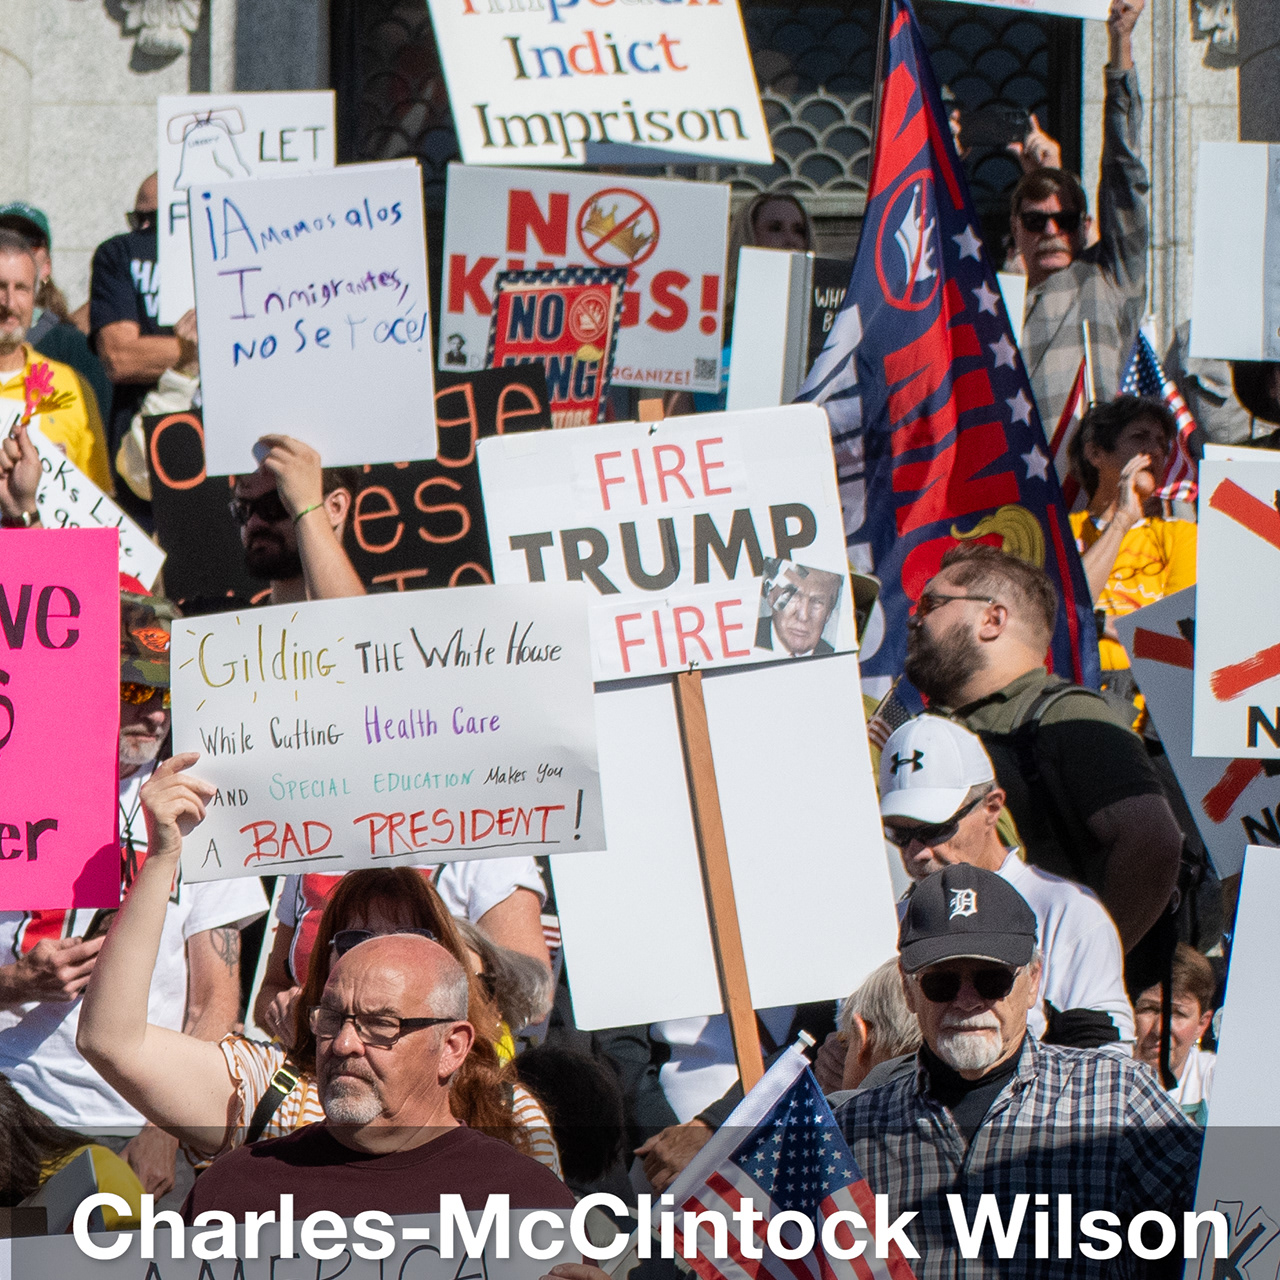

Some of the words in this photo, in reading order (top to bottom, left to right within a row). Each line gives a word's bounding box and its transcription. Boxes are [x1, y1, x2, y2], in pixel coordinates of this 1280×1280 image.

[504, 29, 689, 81] Indict
[258, 126, 327, 163] LET
[473, 99, 749, 159] Imprison
[232, 333, 278, 368] NO
[293, 318, 332, 354] Se
[506, 293, 566, 343] NO
[610, 365, 691, 387] RGANIZE!
[593, 436, 733, 512] FIRE
[508, 502, 818, 597] TRUMP
[354, 640, 406, 675] THE
[409, 625, 496, 670] White
[505, 620, 563, 667] House
[614, 598, 752, 674] FIRE
[198, 719, 255, 758] While
[363, 703, 439, 745] Health
[451, 704, 502, 736] Care
[212, 785, 249, 808] AND
[268, 771, 353, 802] SPECIAL
[373, 767, 476, 795] EDUCATION
[483, 765, 528, 787] Makes
[536, 761, 564, 781] You
[200, 836, 222, 869] A
[239, 818, 334, 868] BAD
